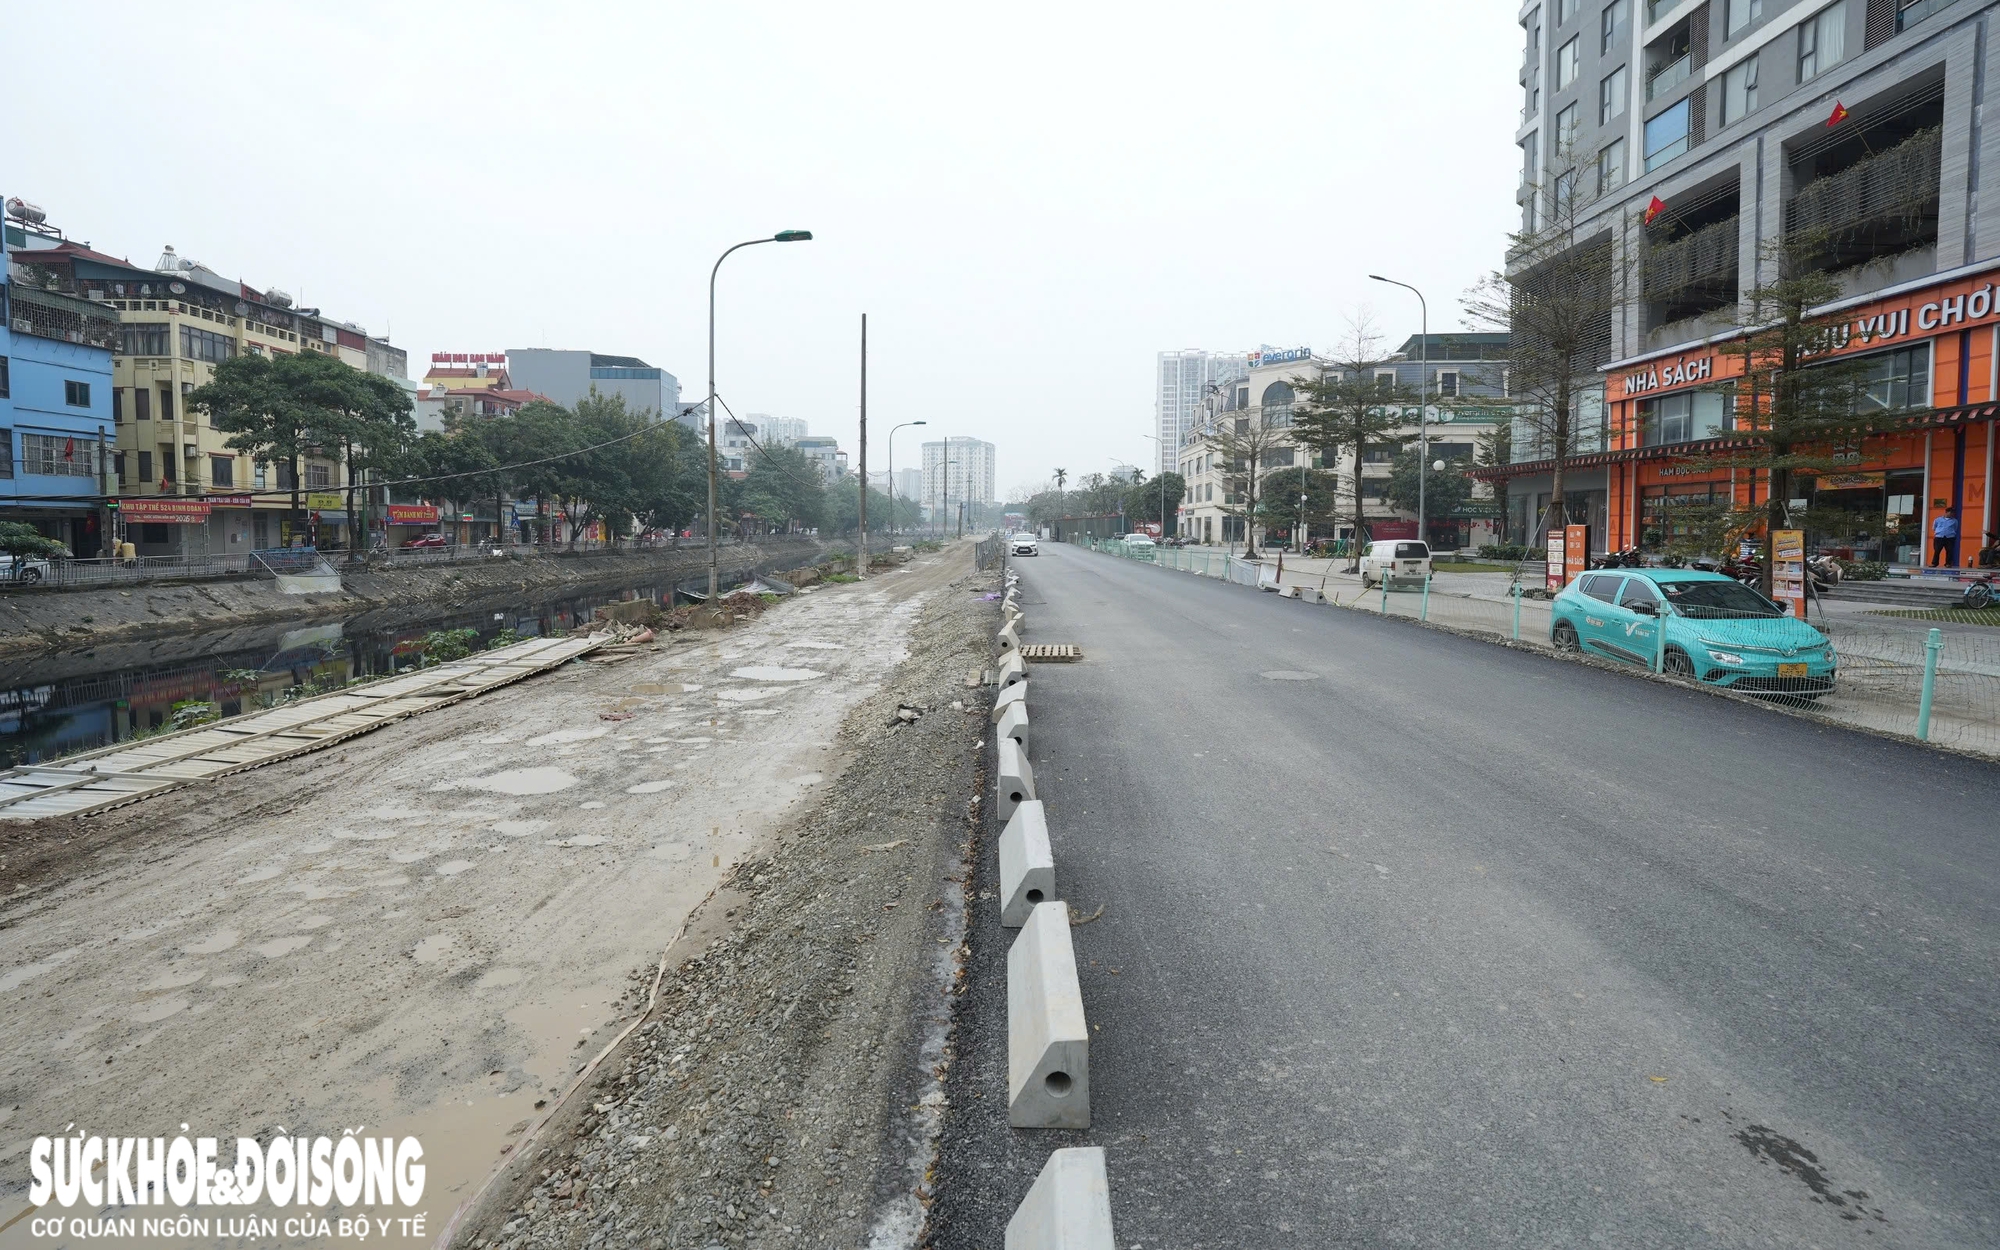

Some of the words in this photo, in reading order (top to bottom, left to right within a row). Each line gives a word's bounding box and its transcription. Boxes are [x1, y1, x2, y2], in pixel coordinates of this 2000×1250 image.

[1858, 308, 1909, 343] VUI
[1625, 364, 1659, 394] NHÀ
[1662, 357, 1712, 386] SÁCH
[1658, 468, 1674, 476] HAM
[135, 503, 148, 512] TẬP
